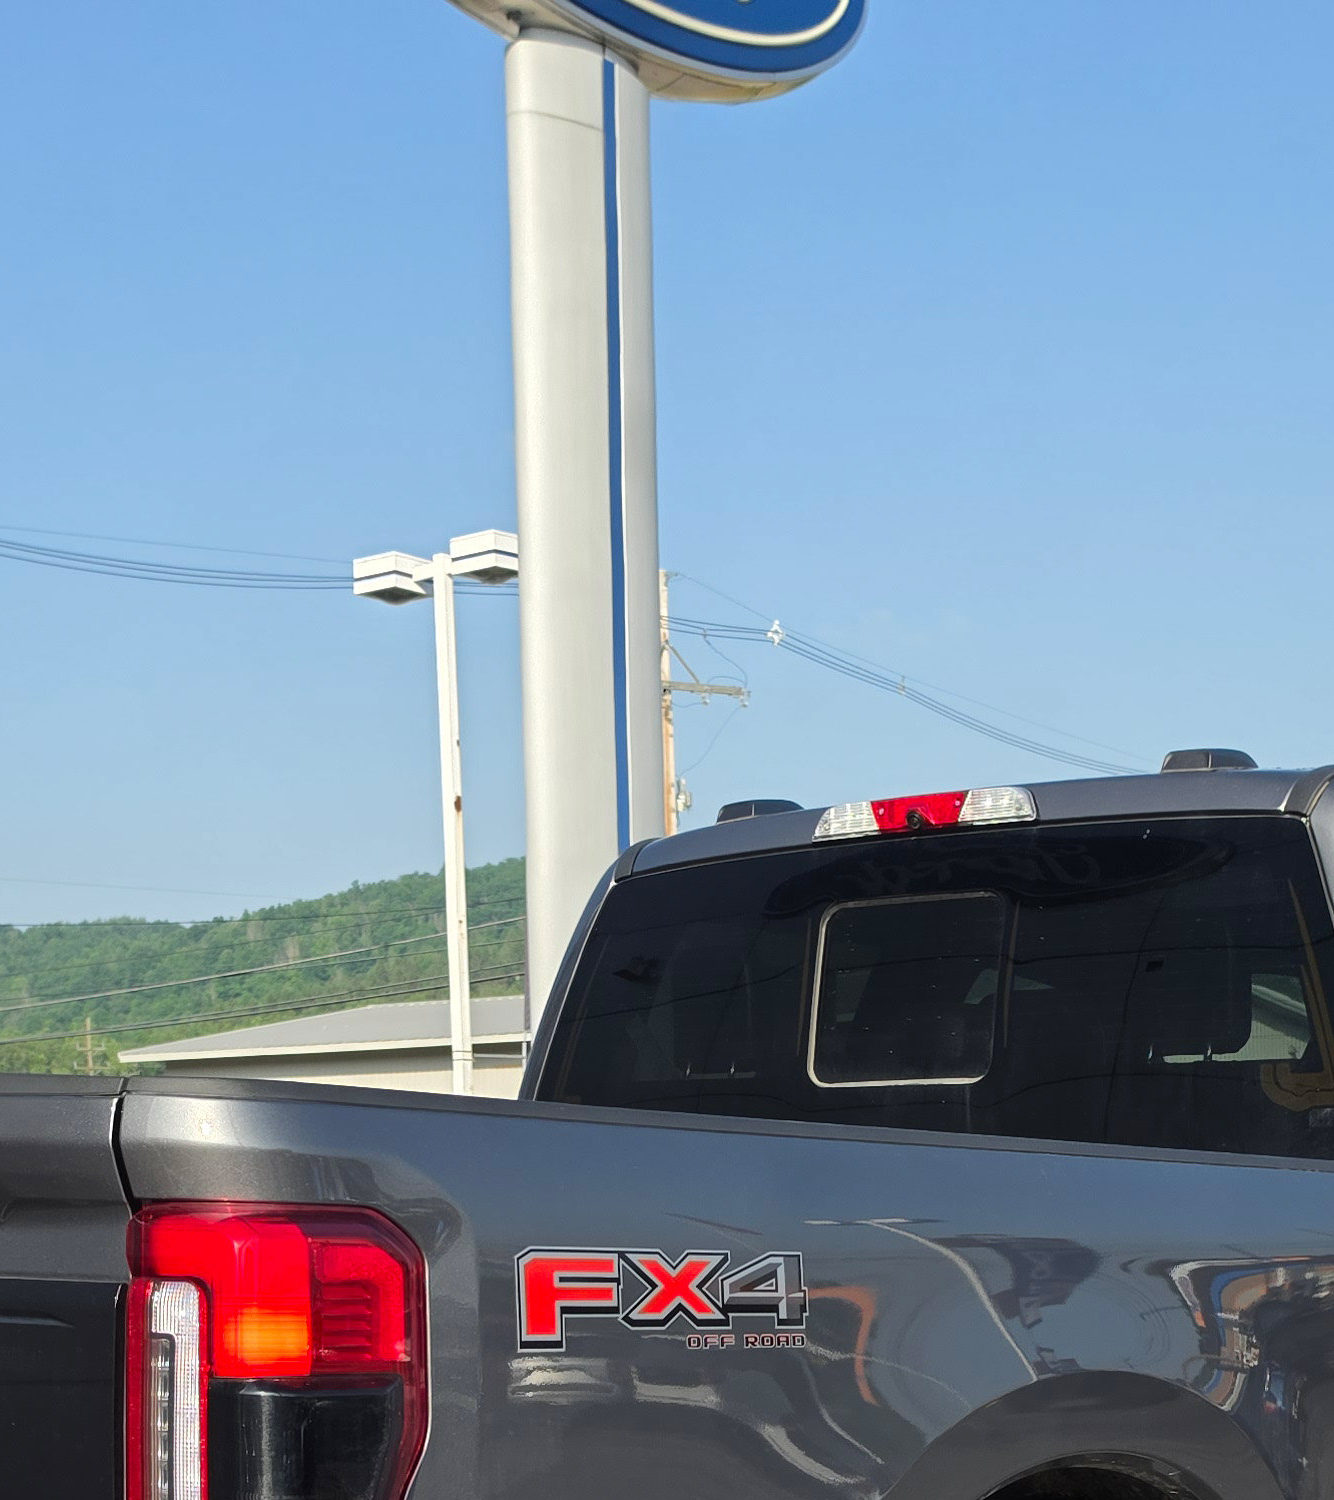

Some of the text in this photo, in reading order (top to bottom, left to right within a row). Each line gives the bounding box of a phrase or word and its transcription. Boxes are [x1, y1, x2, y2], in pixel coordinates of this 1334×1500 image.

[515, 1246, 808, 1352] FX4
[686, 1333, 806, 1349] OFF ROAD
